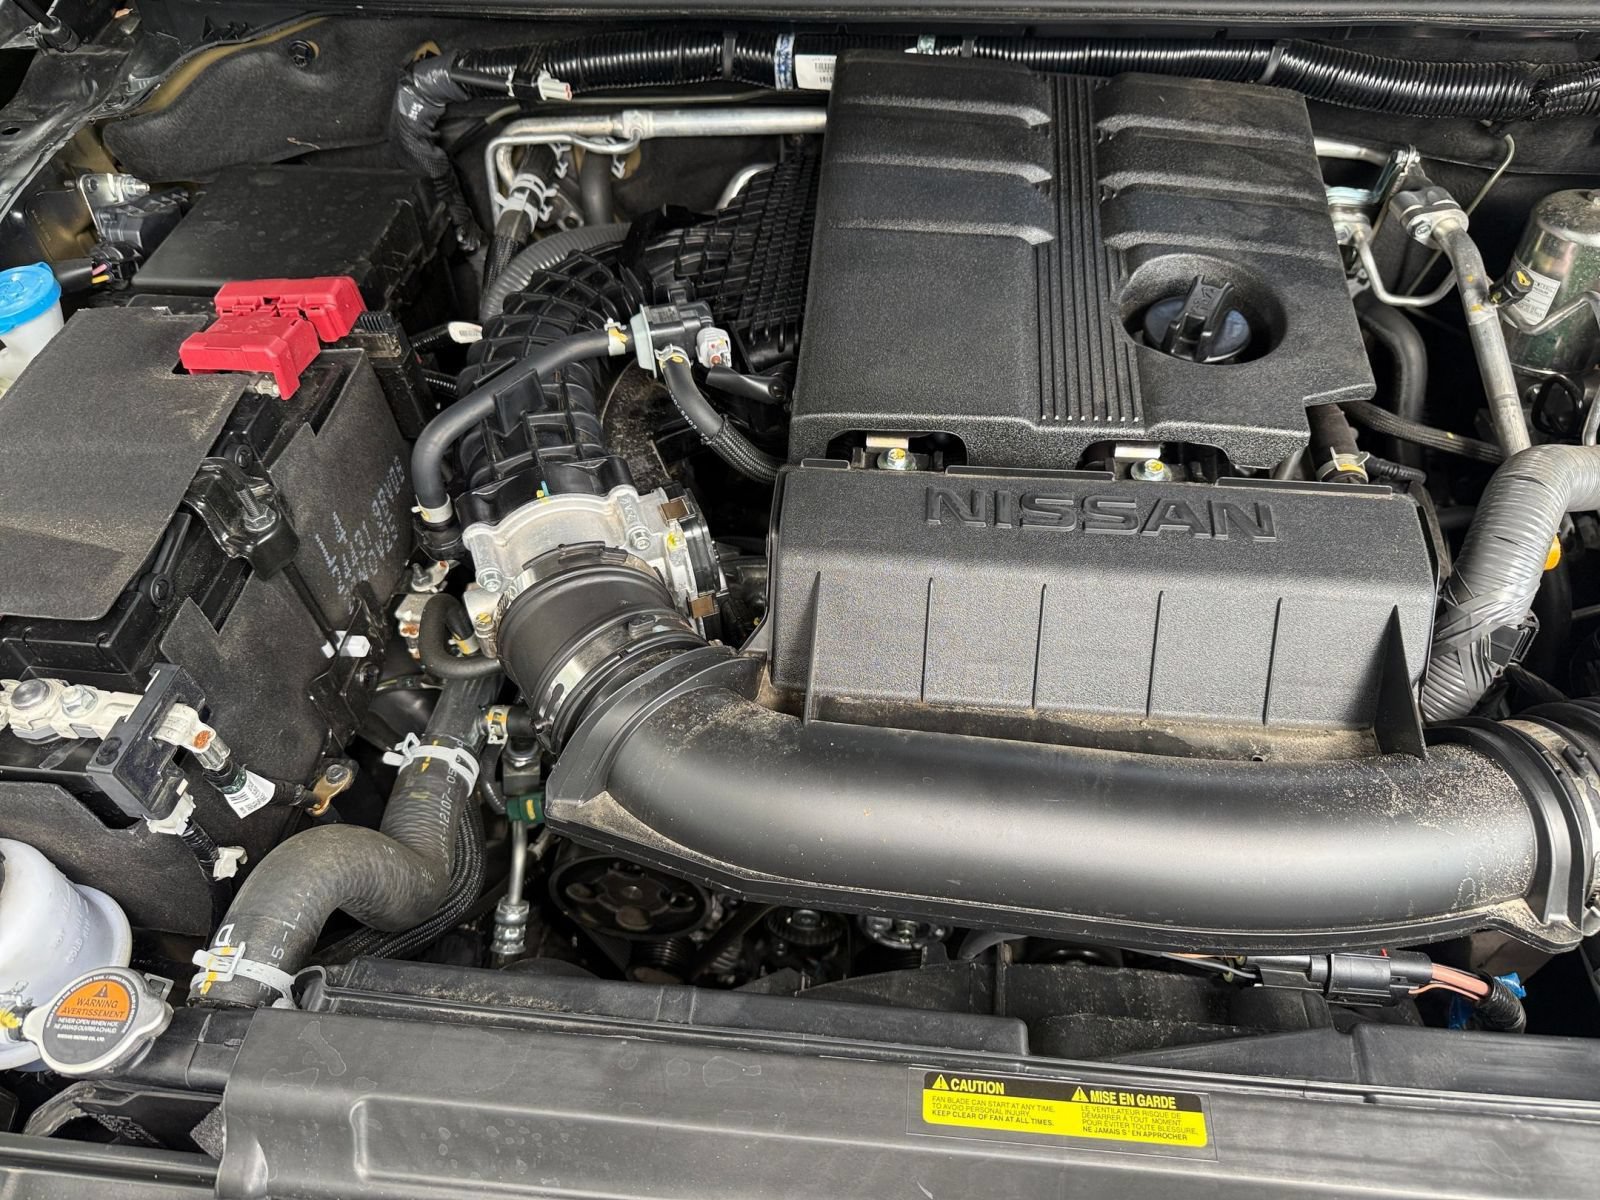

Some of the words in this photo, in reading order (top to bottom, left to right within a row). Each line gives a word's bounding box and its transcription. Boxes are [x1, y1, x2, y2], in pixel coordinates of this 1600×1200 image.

[925, 487, 1277, 542] NISSAN
[75, 997, 119, 1008] WARNING
[61, 1006, 126, 1018] AVERTISSEMENT
[950, 1078, 1005, 1095] CAUTION
[932, 1096, 946, 1104] FAN
[947, 1097, 970, 1106] BLADE
[971, 1099, 987, 1107] CAN
[988, 1100, 1011, 1109] START
[1011, 1102, 1020, 1110] AT
[1020, 1103, 1036, 1112] ANY
[1090, 1090, 1117, 1105] MISE
[1119, 1092, 1135, 1106] EN
[1136, 1094, 1177, 1109] GARDE
[932, 1102, 942, 1110] TO
[943, 1103, 965, 1111] AVOID
[965, 1105, 1004, 1115] PERSONAL
[1081, 1104, 1091, 1112] LE
[1092, 1106, 1141, 1116] VENTILATEUR
[1142, 1109, 1170, 1119] RISQUE
[1171, 1112, 1182, 1120] DE
[952, 1111, 977, 1120] CLEAR
[978, 1113, 988, 1121] OF
[989, 1115, 1004, 1123] FAN
[1031, 1118, 1055, 1127] TIMES.
[1081, 1111, 1121, 1121] DÉMARRER
[1129, 1115, 1149, 1124] TOUT
[1151, 1117, 1182, 1127] MOMENT
[1082, 1119, 1102, 1127] POUR
[1103, 1119, 1130, 1129] ÉVITER
[1131, 1122, 1156, 1132] TOUTE
[1082, 1126, 1093, 1134] NE
[1094, 1127, 1120, 1136] JAMAIS
[1131, 1130, 1142, 1138] EN
[1143, 1131, 1188, 1141] APPROCHER
